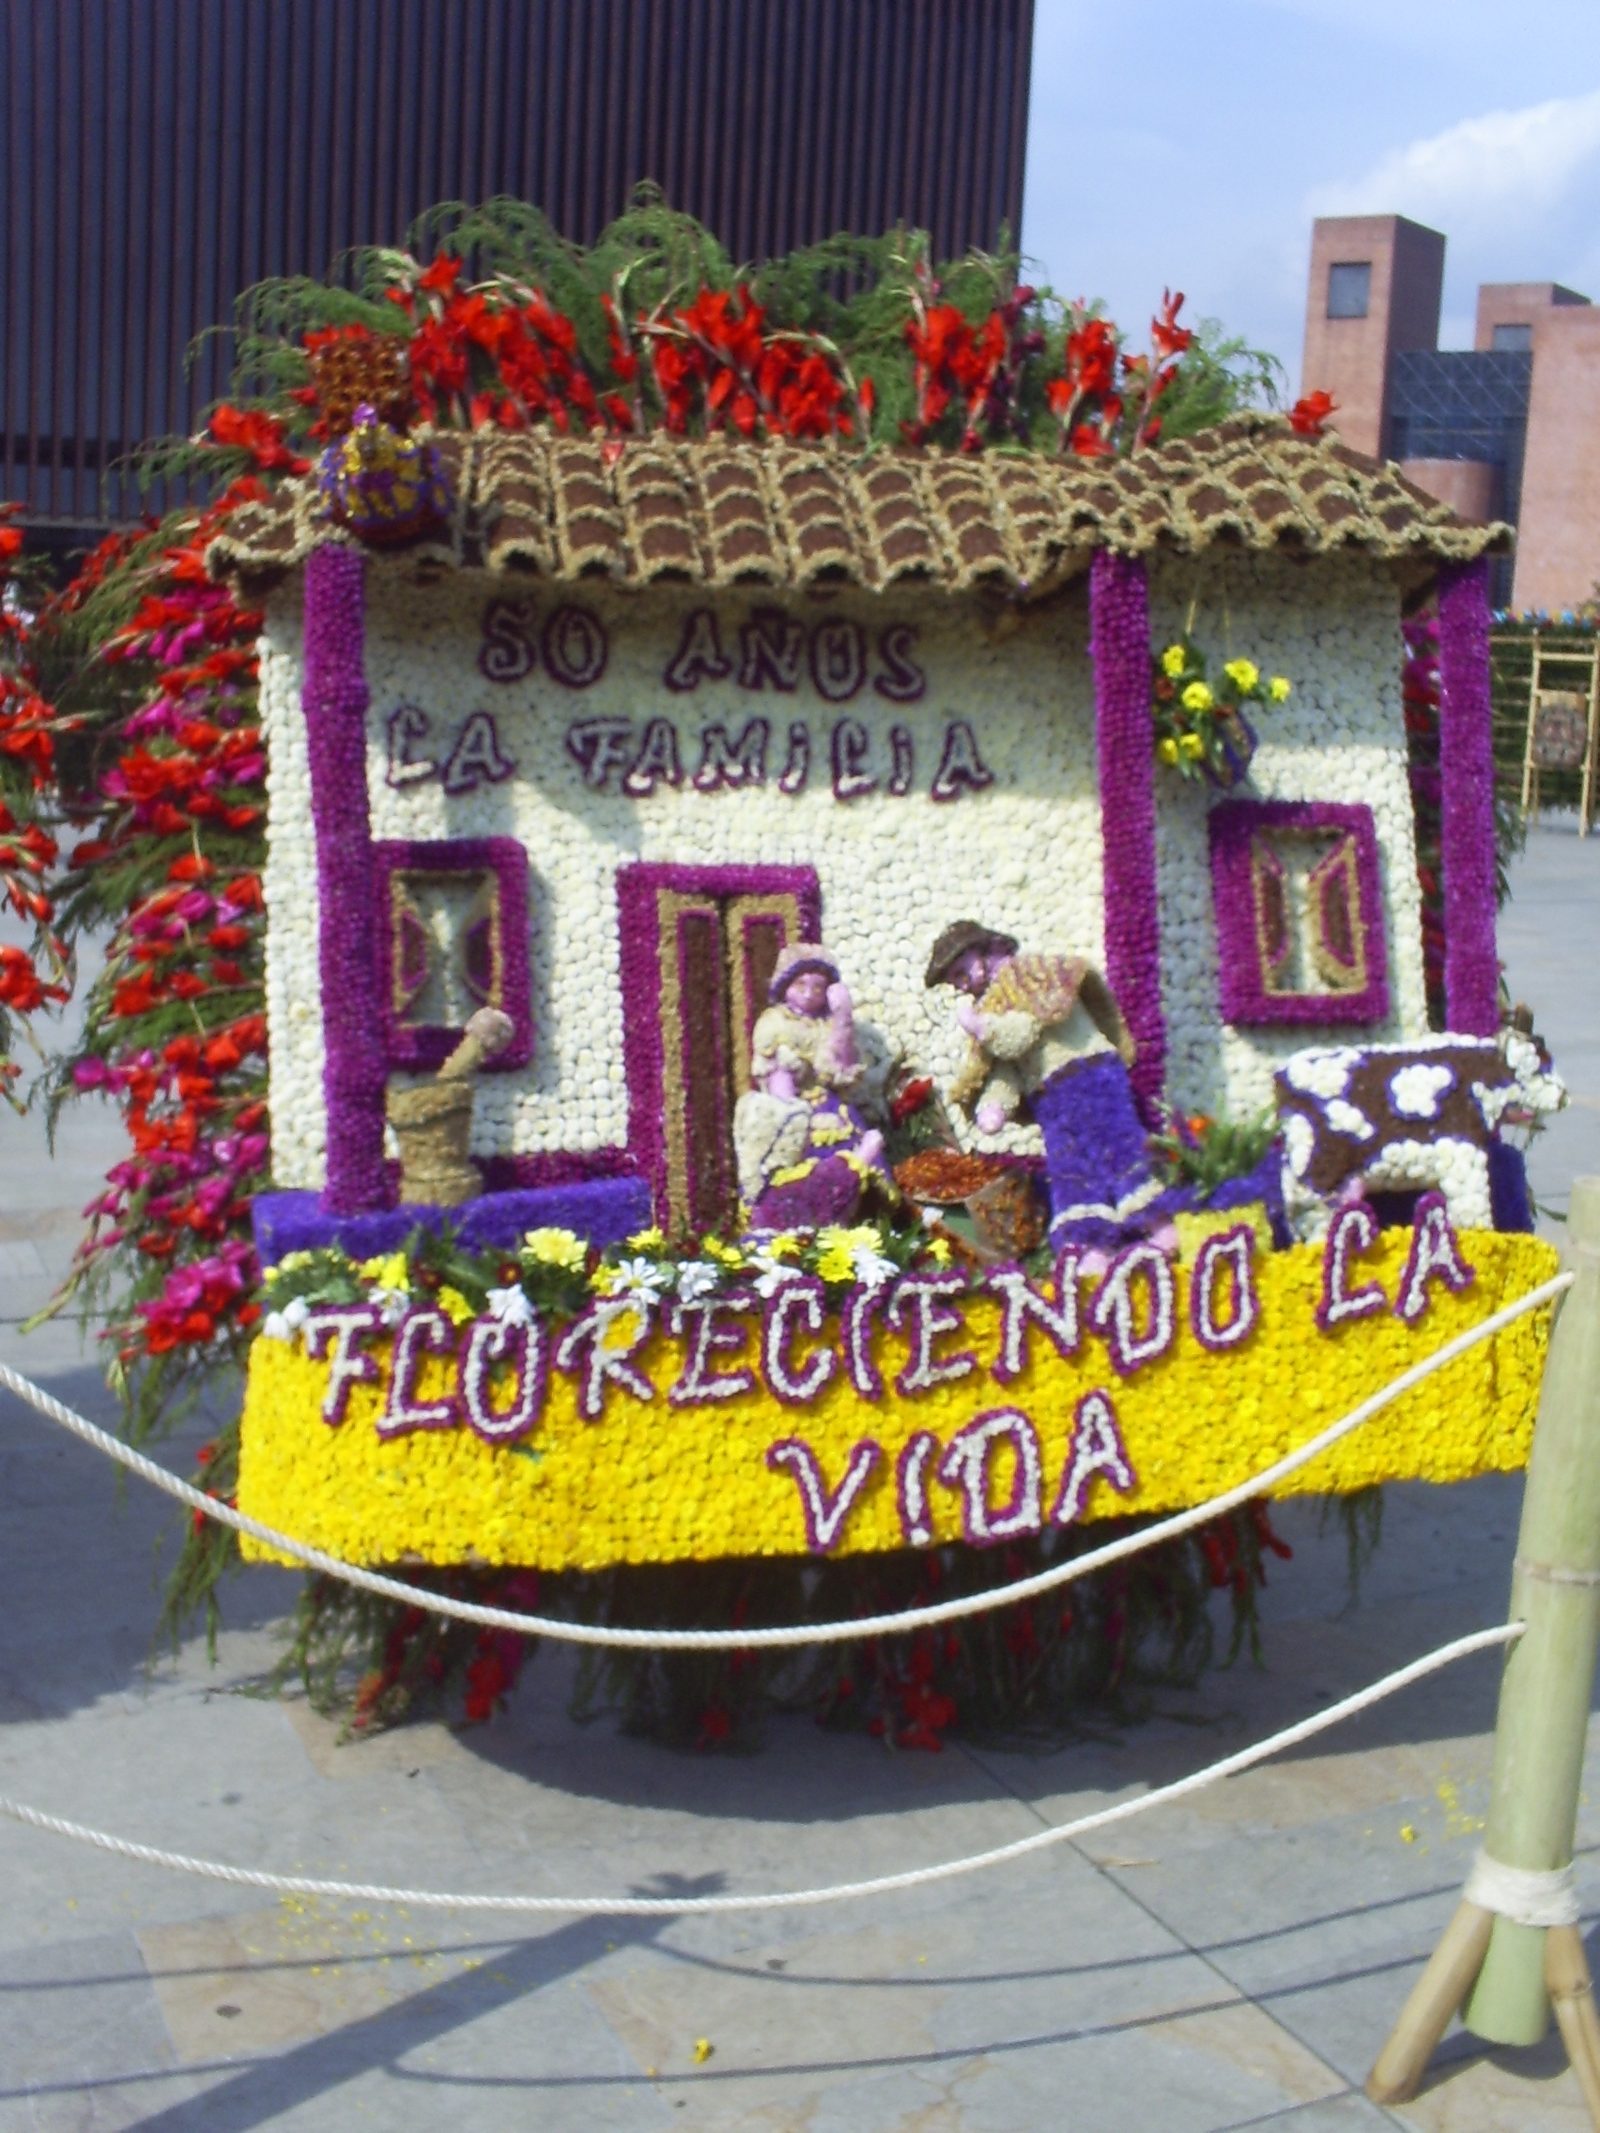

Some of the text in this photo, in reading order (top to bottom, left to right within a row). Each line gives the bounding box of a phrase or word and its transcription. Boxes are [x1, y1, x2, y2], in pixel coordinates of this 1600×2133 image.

[662, 604, 927, 702] AÑOS
[384, 704, 994, 801] LA FAMILIA
[301, 1192, 1474, 1443] FLORECIENDO LA
[766, 1388, 1136, 1553] VIDA
